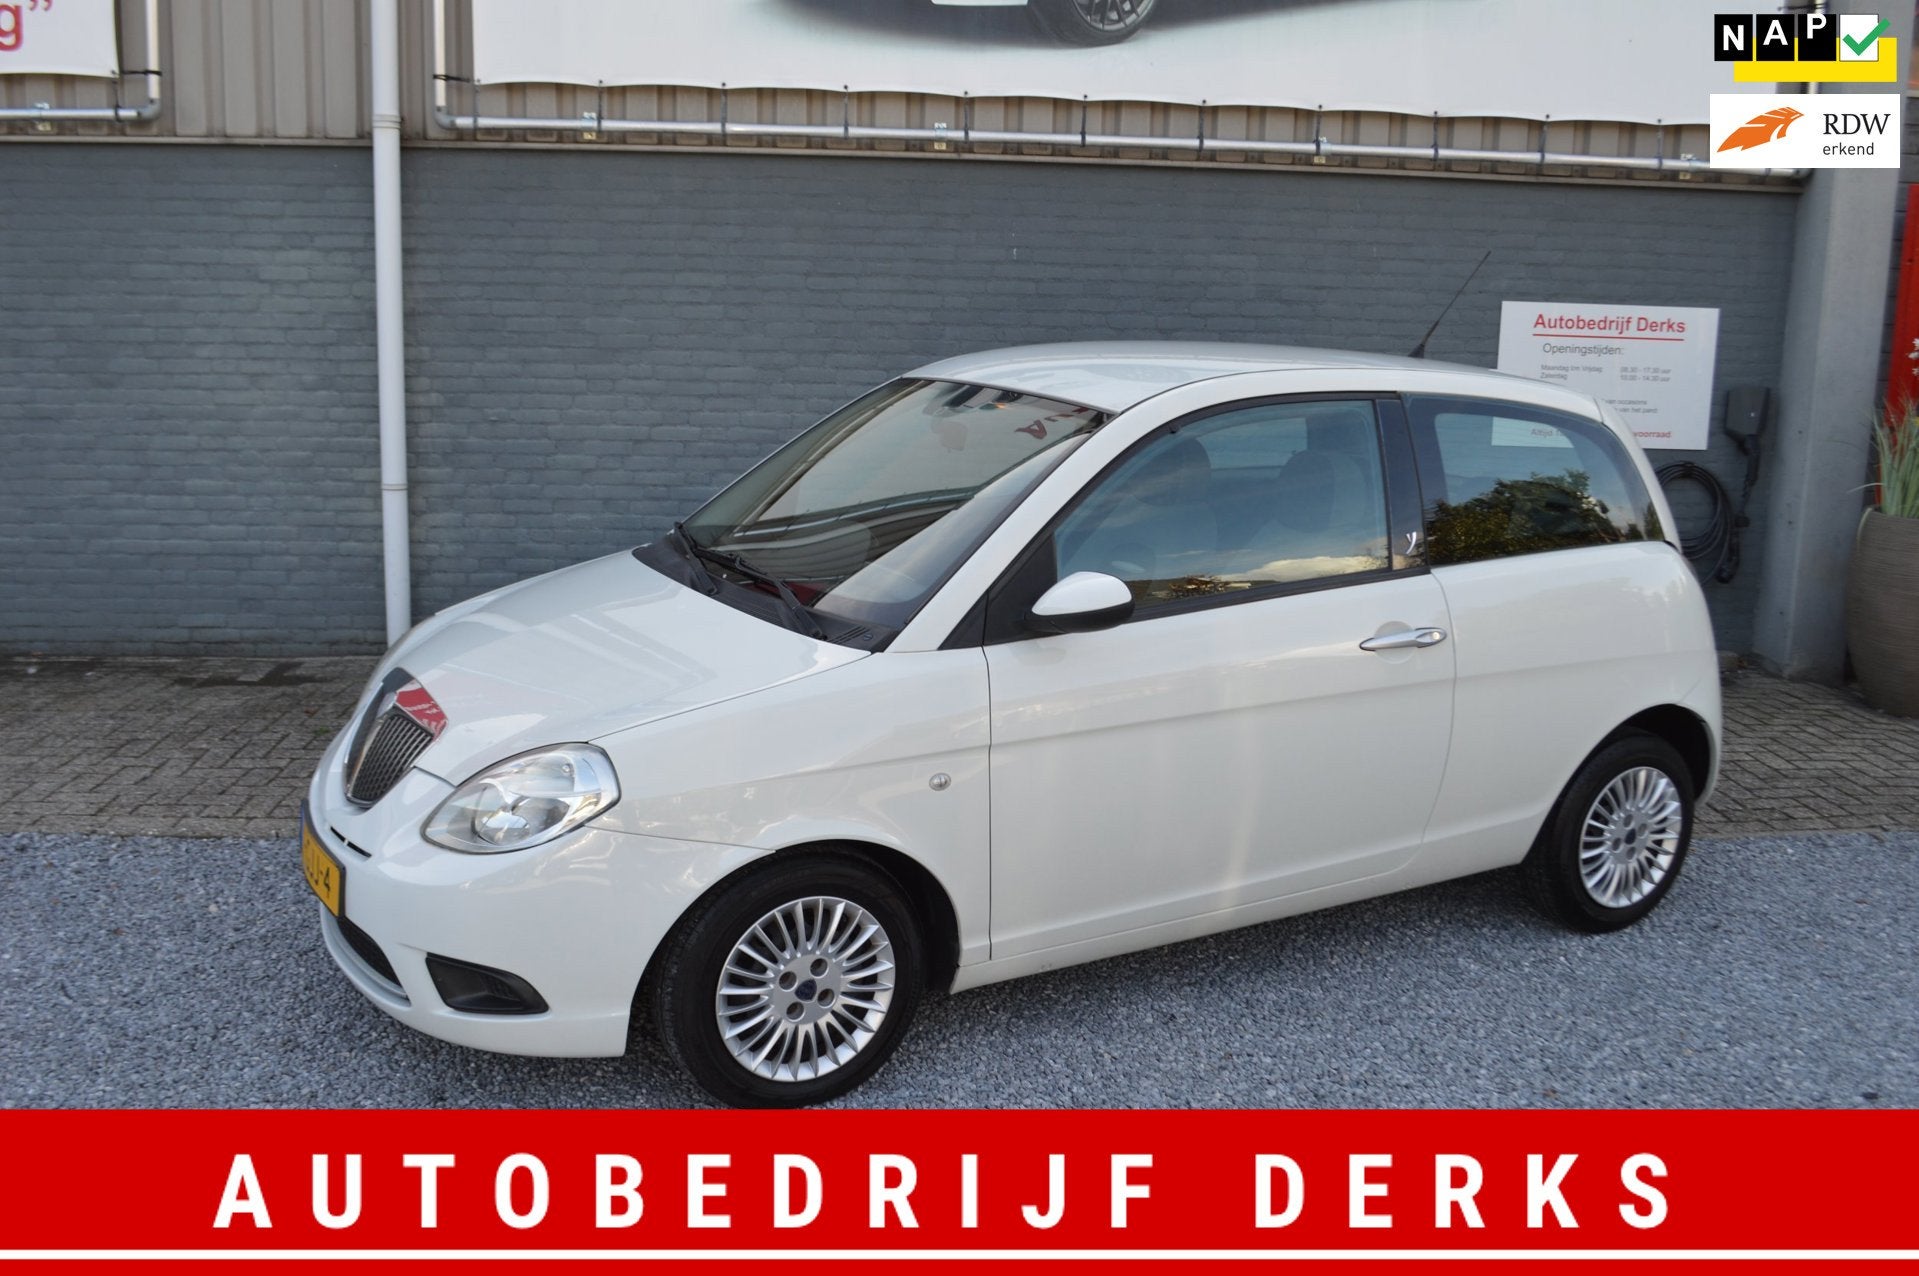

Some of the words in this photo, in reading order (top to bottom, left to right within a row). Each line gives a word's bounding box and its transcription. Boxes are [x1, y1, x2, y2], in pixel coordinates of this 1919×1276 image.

[1533, 313, 1632, 335] Autobedrijf
[1636, 316, 1686, 334] Derks
[1542, 342, 1625, 357] Openingstijden:
